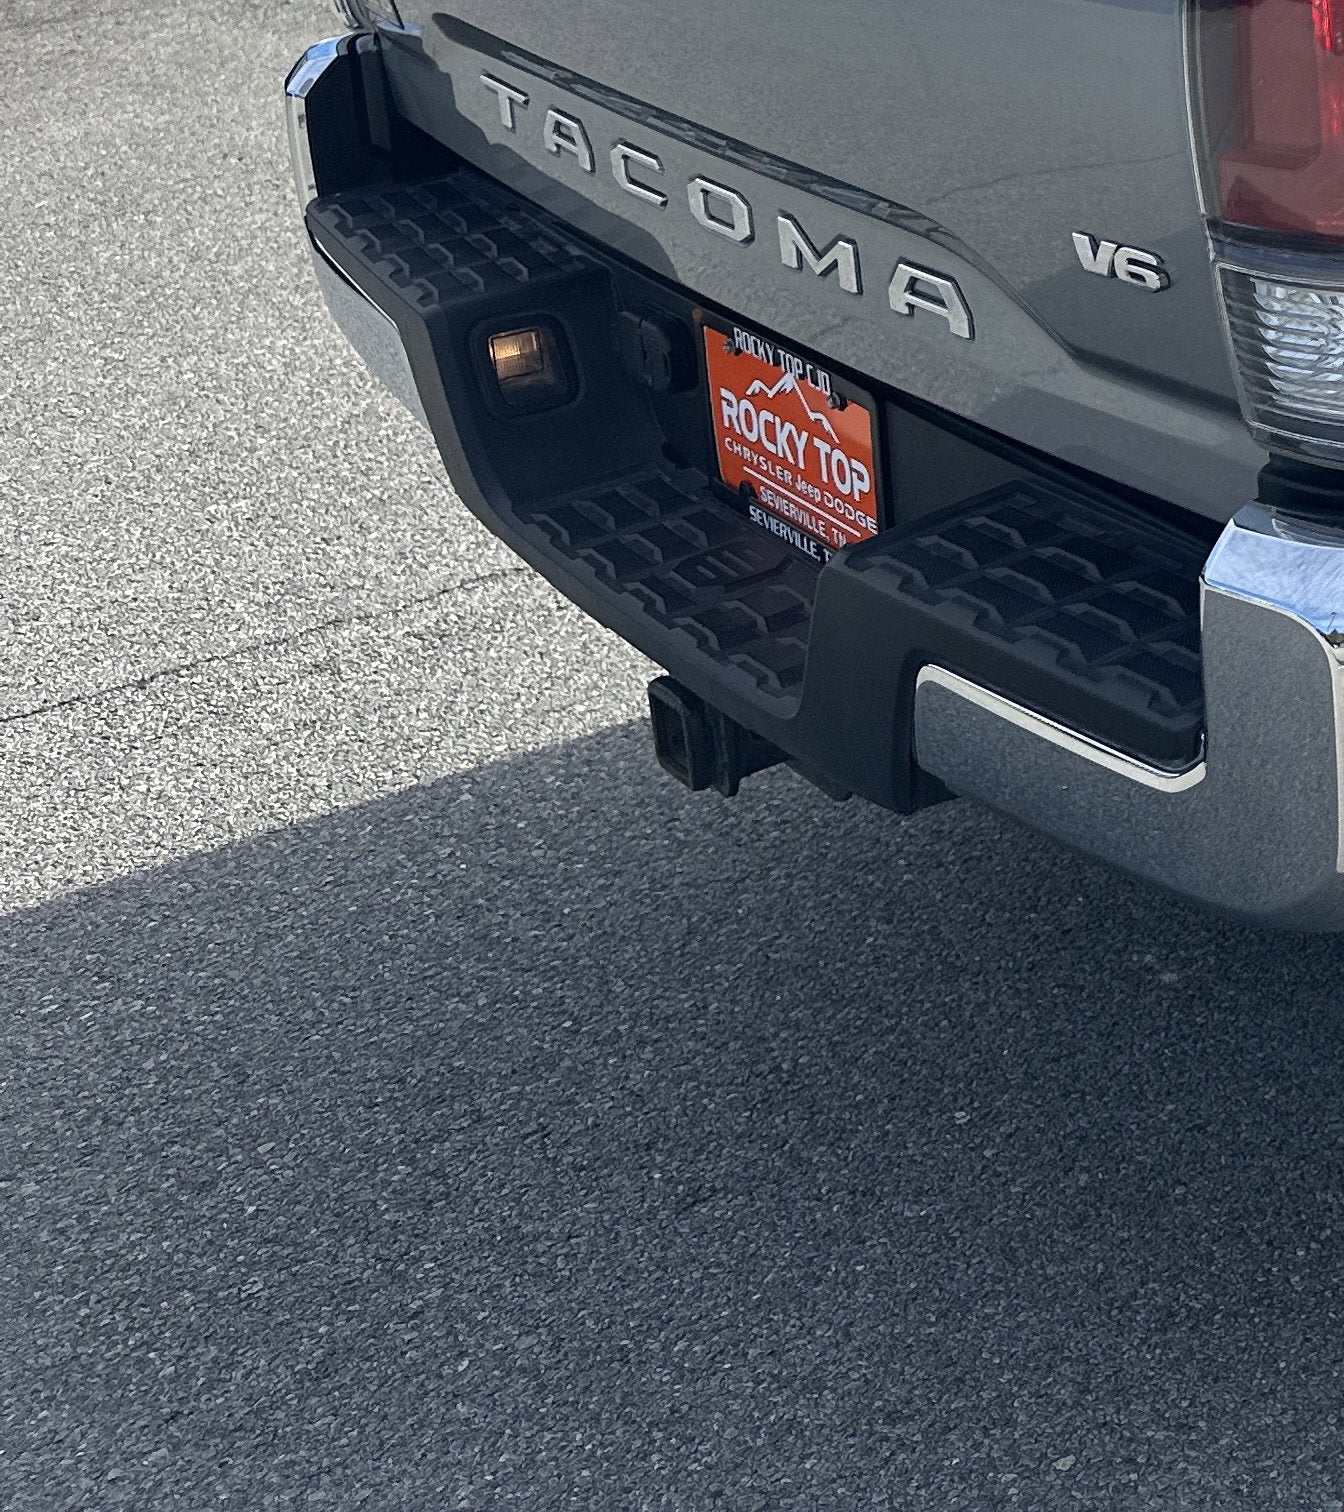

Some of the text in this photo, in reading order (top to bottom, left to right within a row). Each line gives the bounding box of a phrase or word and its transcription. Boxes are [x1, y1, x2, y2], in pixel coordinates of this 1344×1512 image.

[480, 72, 974, 340] TACOMA
[1071, 230, 1170, 293] V6
[733, 327, 831, 396] ROCKY TOP CJD
[720, 387, 871, 502] ROCKY TOP
[724, 437, 878, 534] CHRYSLER Jeep DODGE
[759, 485, 830, 543] SEVIERVILLE,
[749, 505, 821, 562] SEVIERVILLE,
